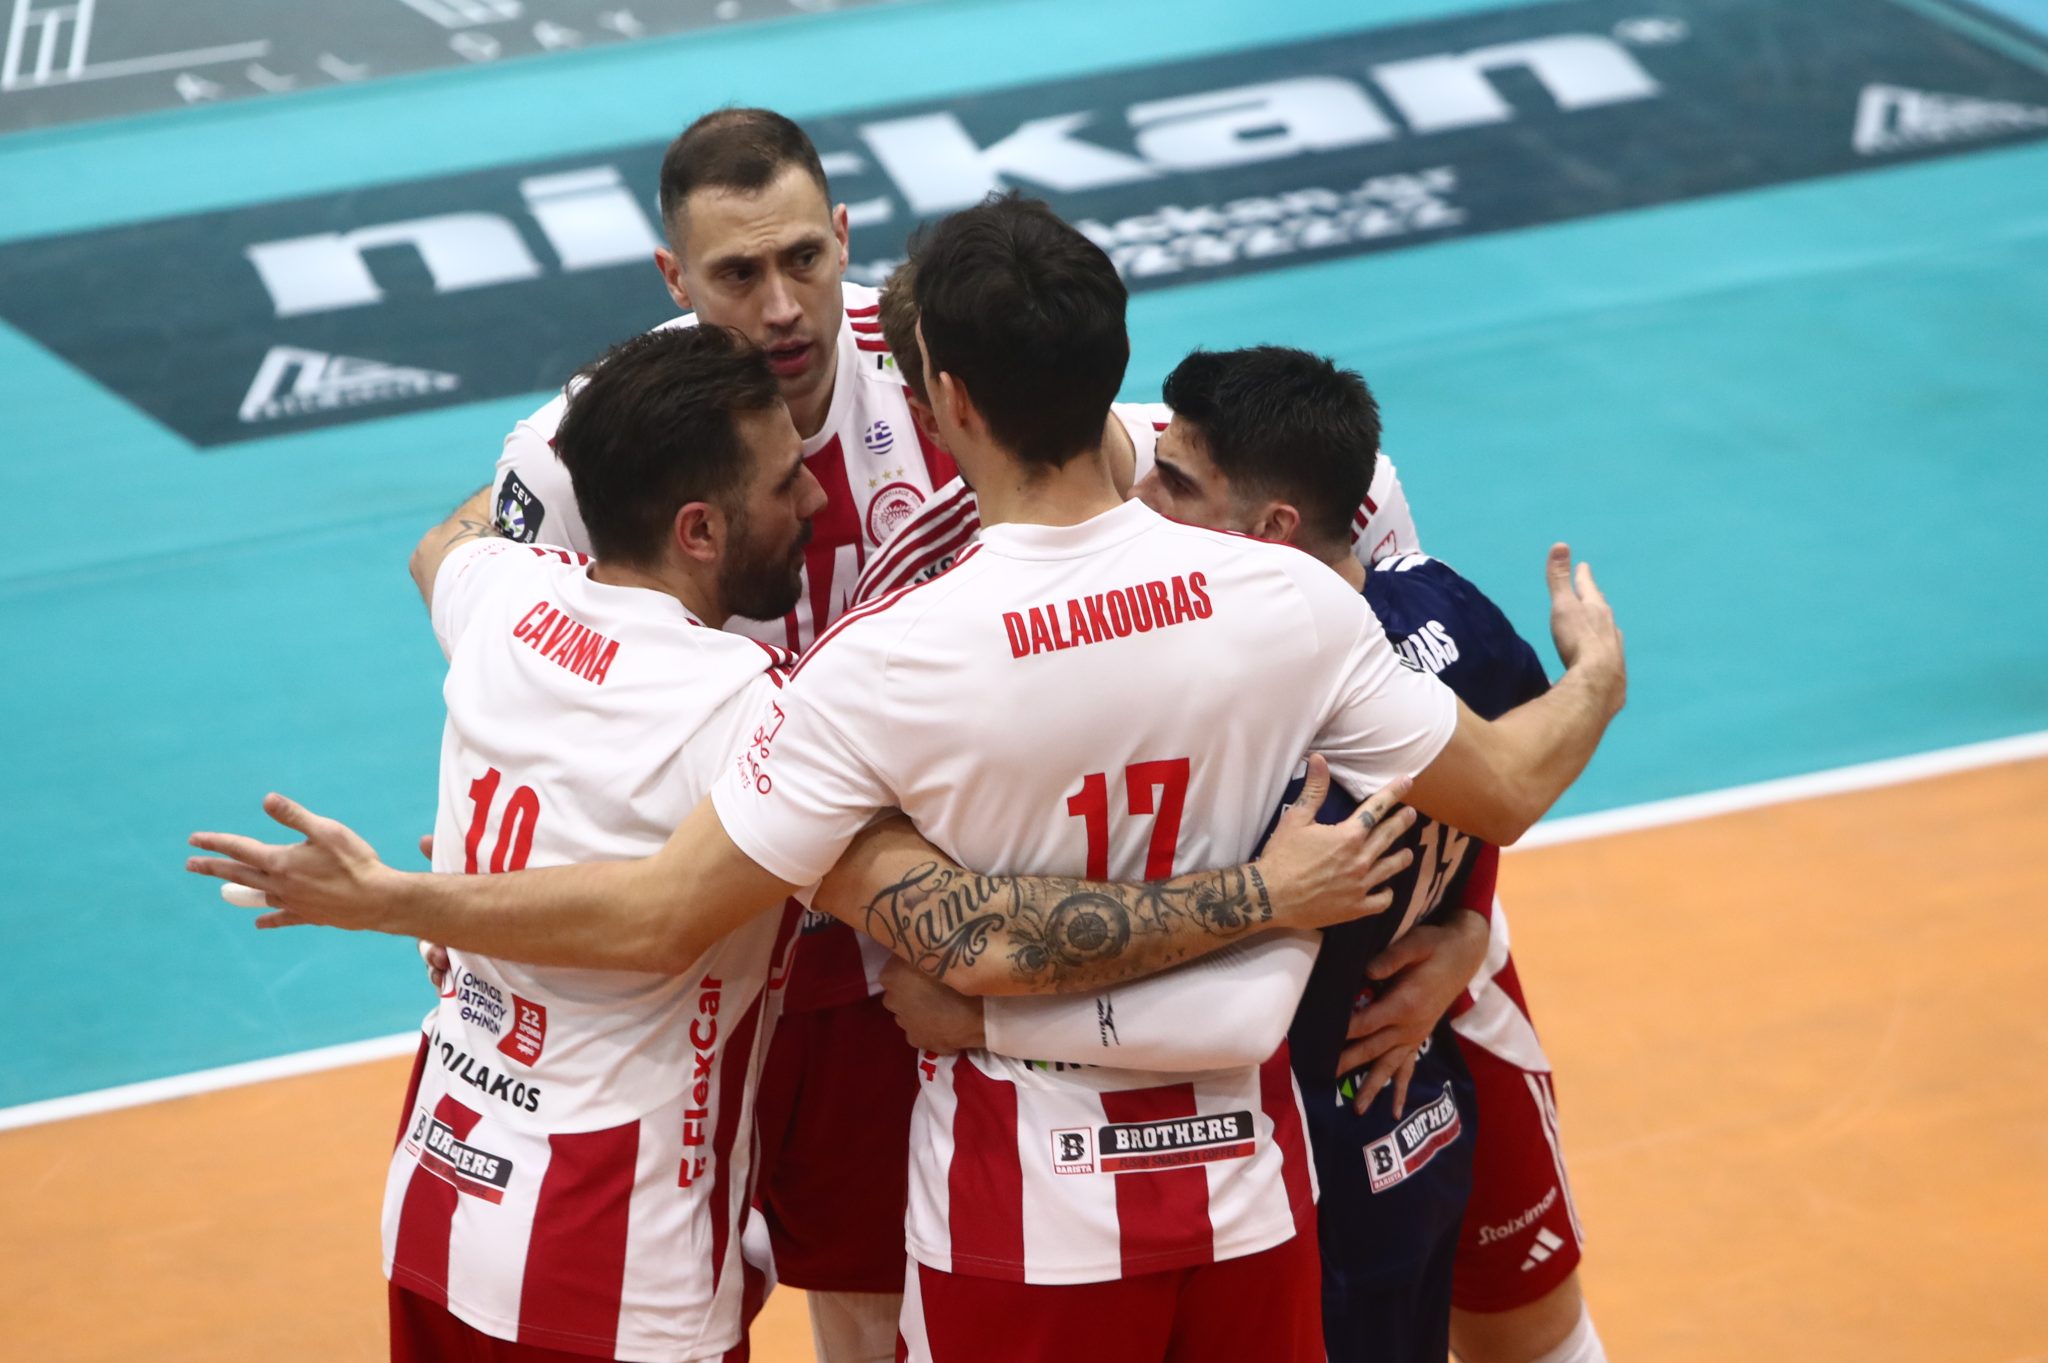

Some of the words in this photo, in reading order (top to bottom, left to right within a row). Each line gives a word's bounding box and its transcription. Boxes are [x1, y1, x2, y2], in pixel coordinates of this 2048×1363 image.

[247, 32, 1662, 317] nikan
[512, 482, 531, 506] CEV
[513, 601, 620, 685] CAVANNA
[1002, 571, 1213, 659] DALAKOURAS
[467, 767, 540, 873] 10
[1067, 757, 1190, 882] 17
[683, 973, 722, 1156] FlexCar
[1058, 1133, 1085, 1162] B
[1114, 1116, 1240, 1151] BROTHERS
[1202, 1146, 1240, 1161] COFFEE
[1372, 1144, 1393, 1176] B
[1056, 1164, 1094, 1175] BARISTA
